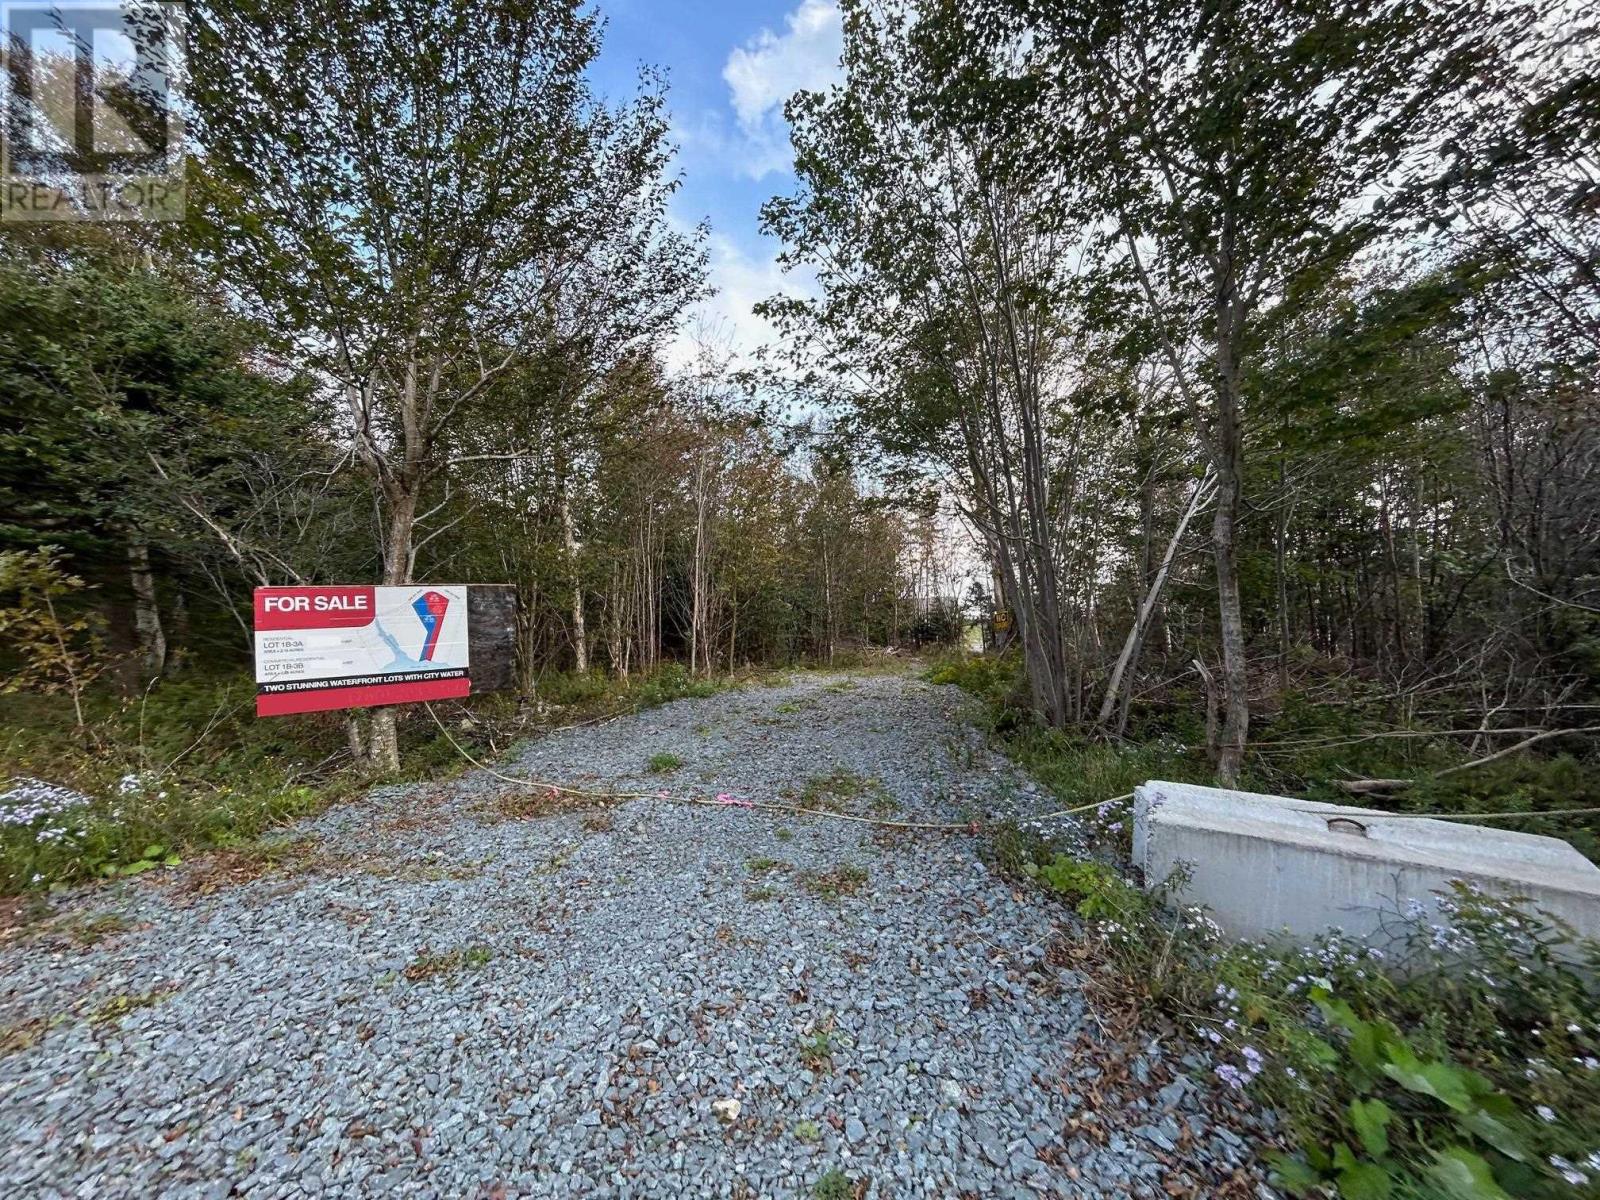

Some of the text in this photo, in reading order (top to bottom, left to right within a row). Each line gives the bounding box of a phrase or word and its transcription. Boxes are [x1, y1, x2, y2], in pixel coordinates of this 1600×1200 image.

[264, 595, 368, 612] FOR SALE
[282, 662, 304, 670] 1B-3B
[264, 670, 464, 692] TWO STUNNING WATERFRONT LOTS WITH CITY WATER
